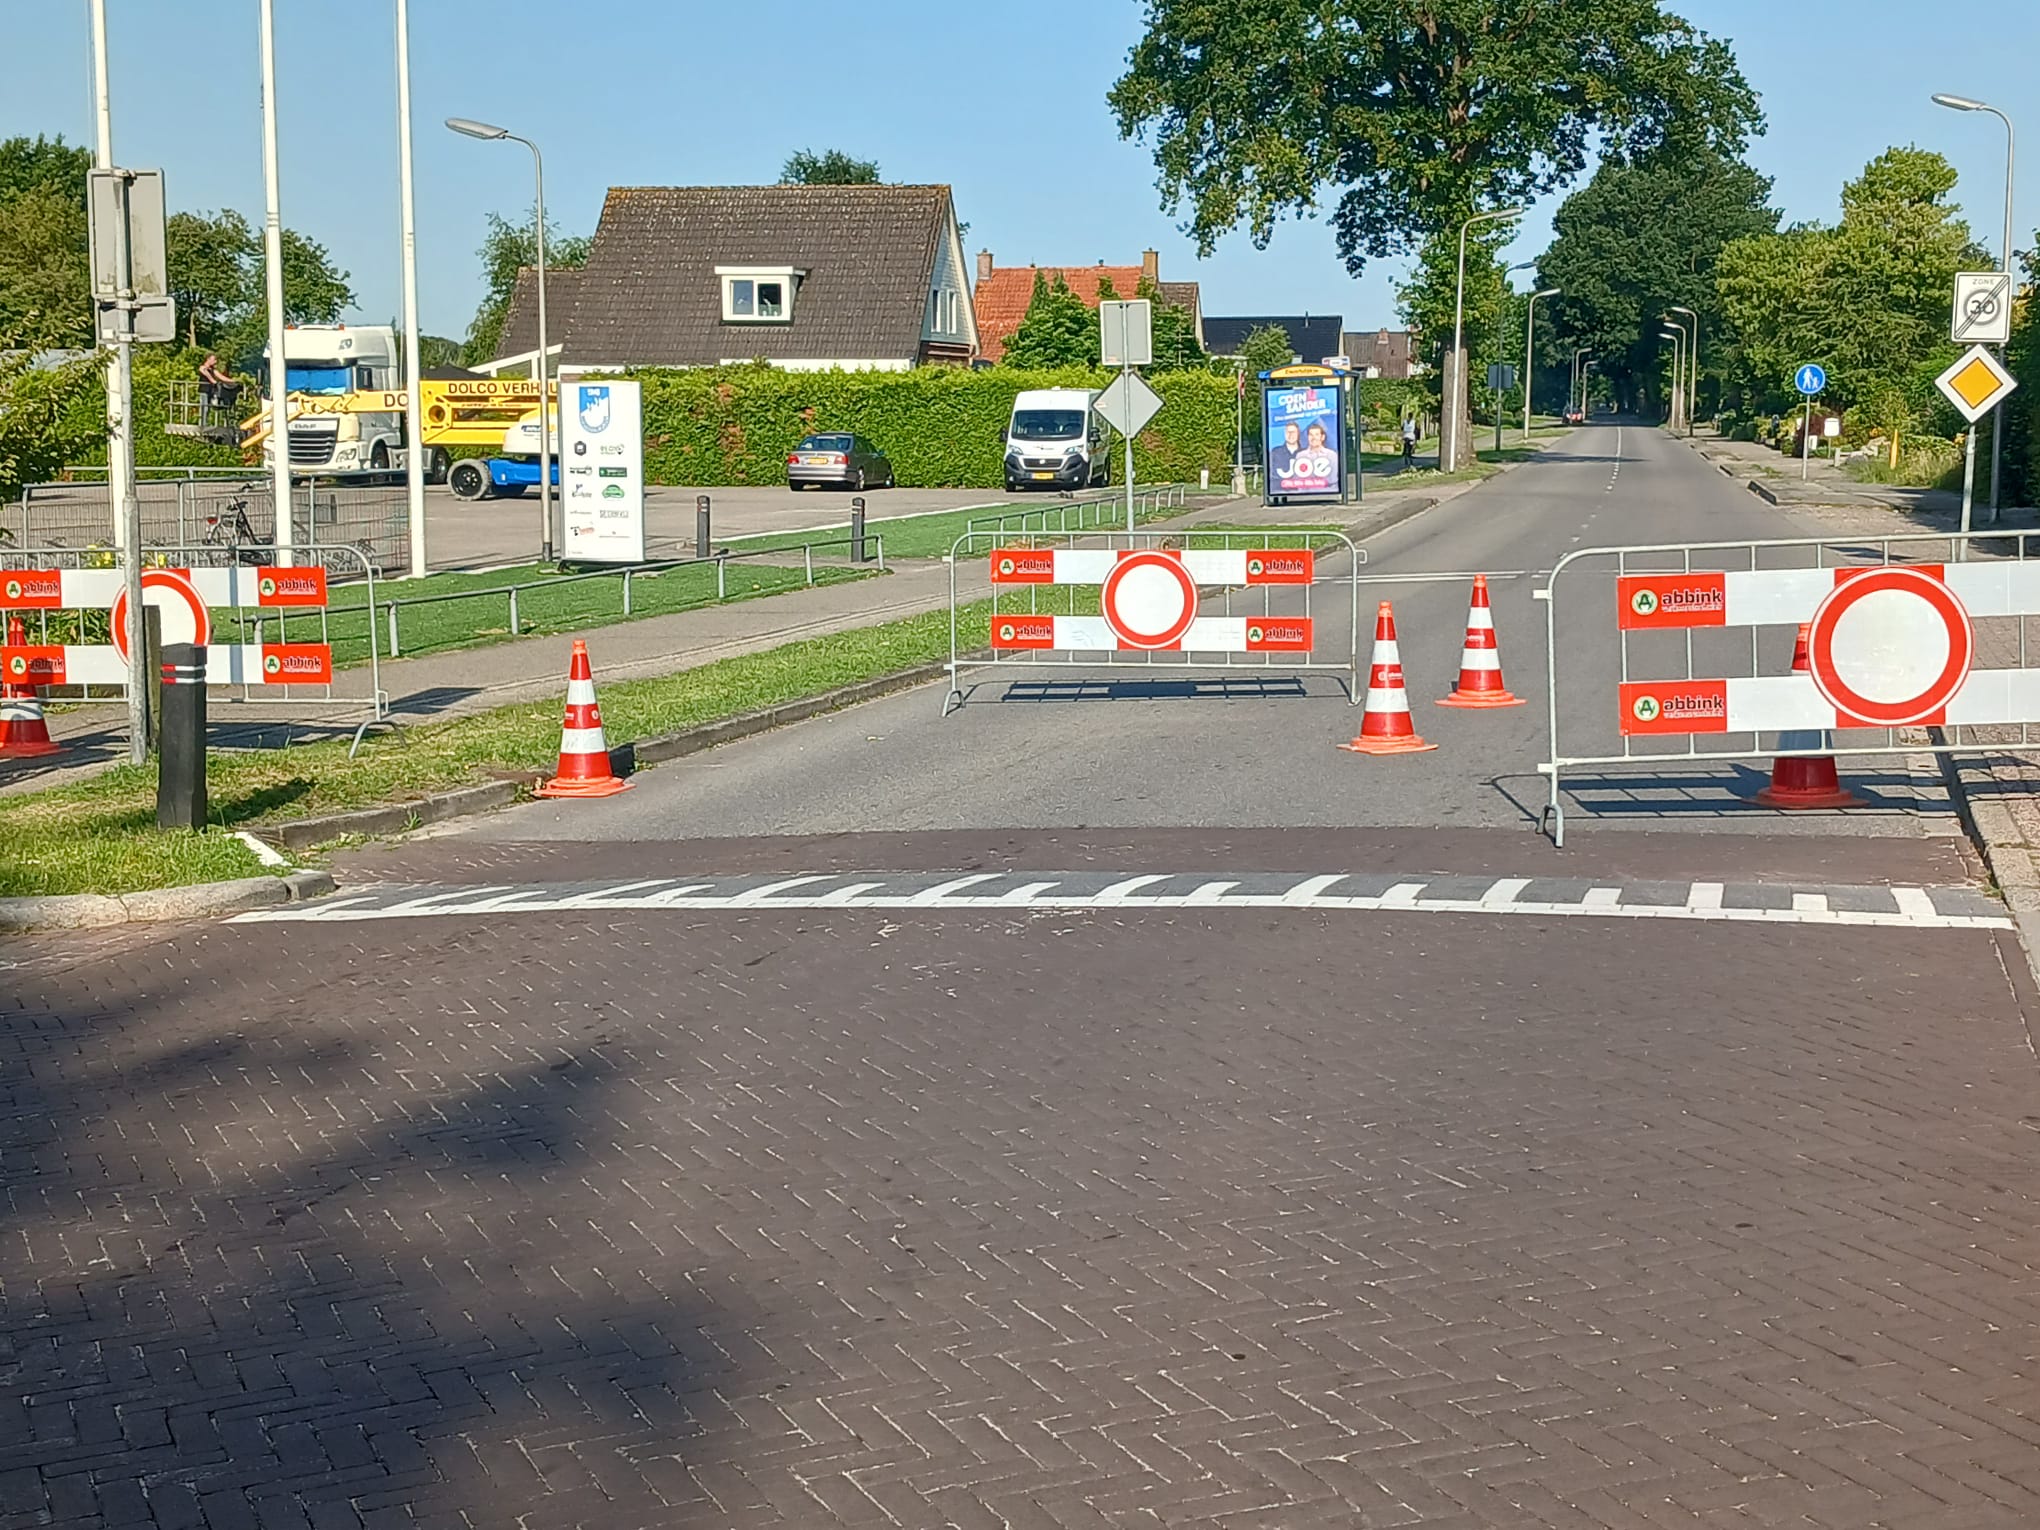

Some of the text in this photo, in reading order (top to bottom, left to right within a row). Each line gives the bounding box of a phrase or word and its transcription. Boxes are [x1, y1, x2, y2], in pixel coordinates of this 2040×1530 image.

[1970, 299, 1995, 315] 30
[448, 383, 497, 394] DOLCO
[1662, 588, 1722, 605] abbink
[1664, 694, 1723, 711] abbink
